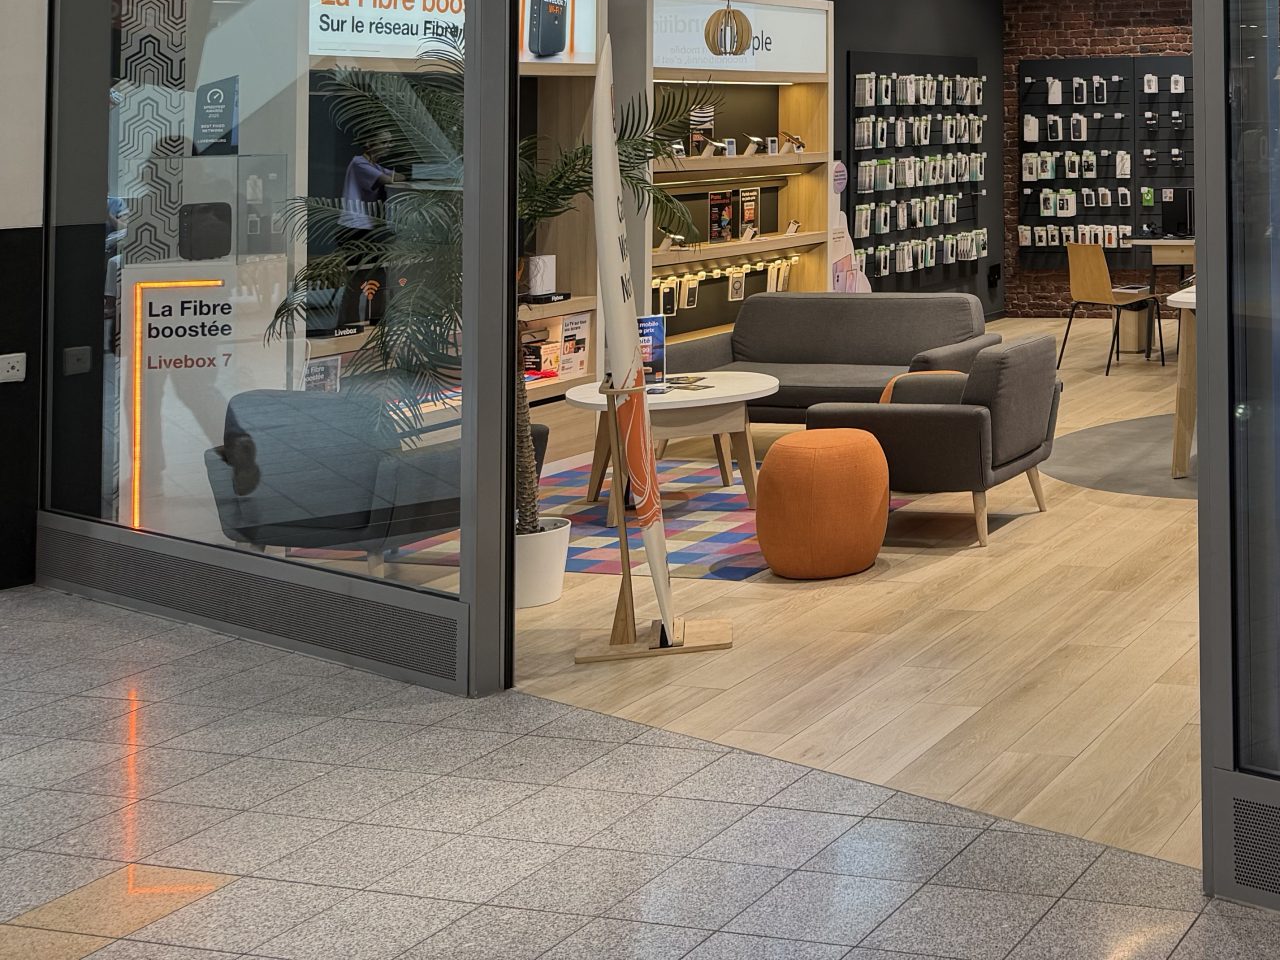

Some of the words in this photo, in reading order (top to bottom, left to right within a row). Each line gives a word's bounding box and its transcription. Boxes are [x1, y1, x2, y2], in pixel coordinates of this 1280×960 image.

[319, 13, 347, 33] Sur
[351, 16, 365, 33] le
[368, 17, 419, 36] réseau
[148, 301, 173, 318] La
[180, 299, 233, 317] Fibre
[147, 320, 233, 339] boostée
[334, 327, 357, 337] Livebox
[147, 354, 217, 370] Livebox
[222, 353, 233, 367] 7
